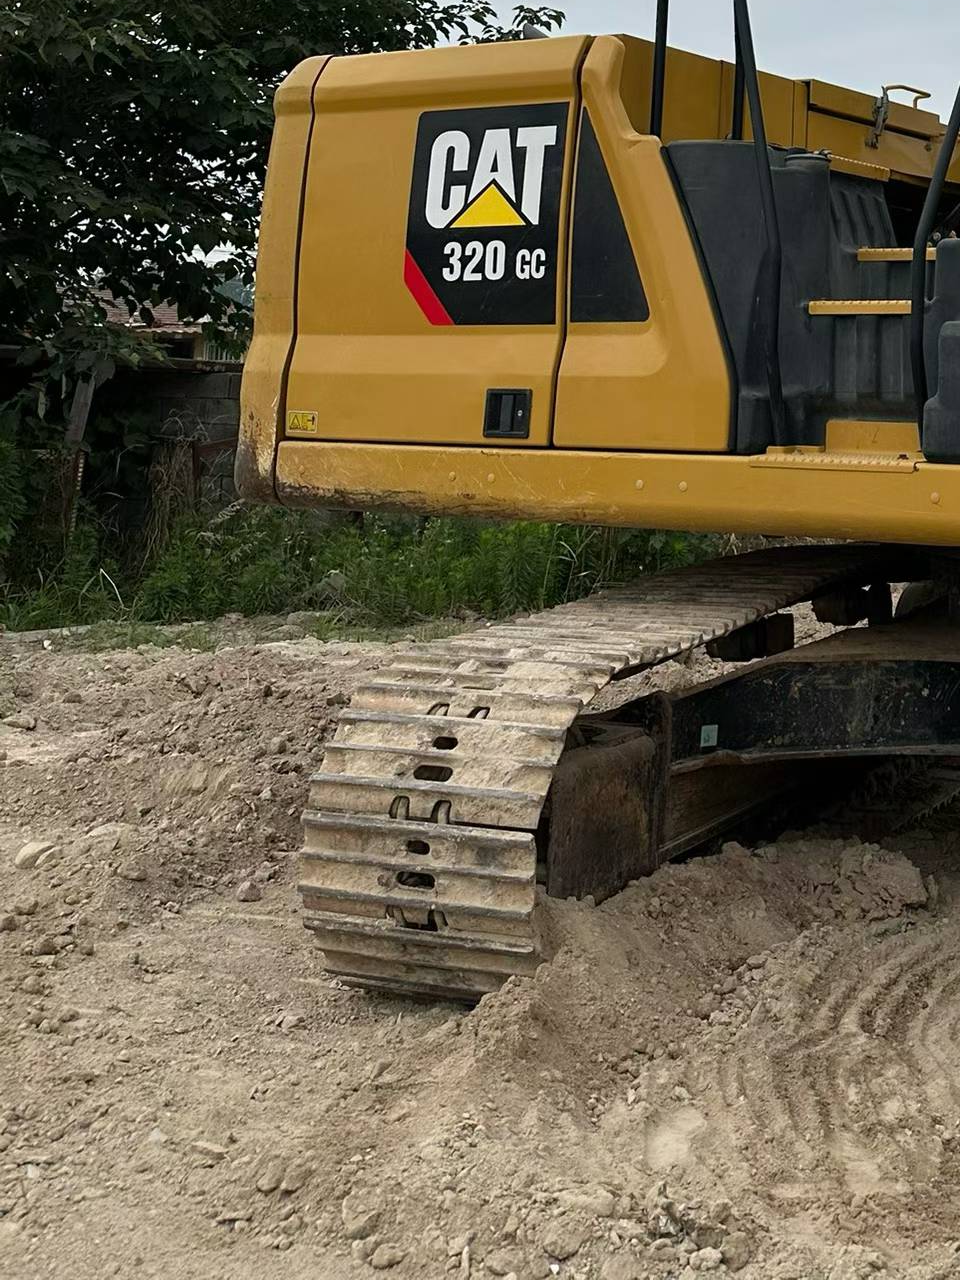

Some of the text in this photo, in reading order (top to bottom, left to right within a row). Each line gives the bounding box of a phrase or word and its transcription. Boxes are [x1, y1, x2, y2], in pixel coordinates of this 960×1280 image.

[425, 125, 557, 229] CAT
[442, 240, 546, 282] 320 GC
